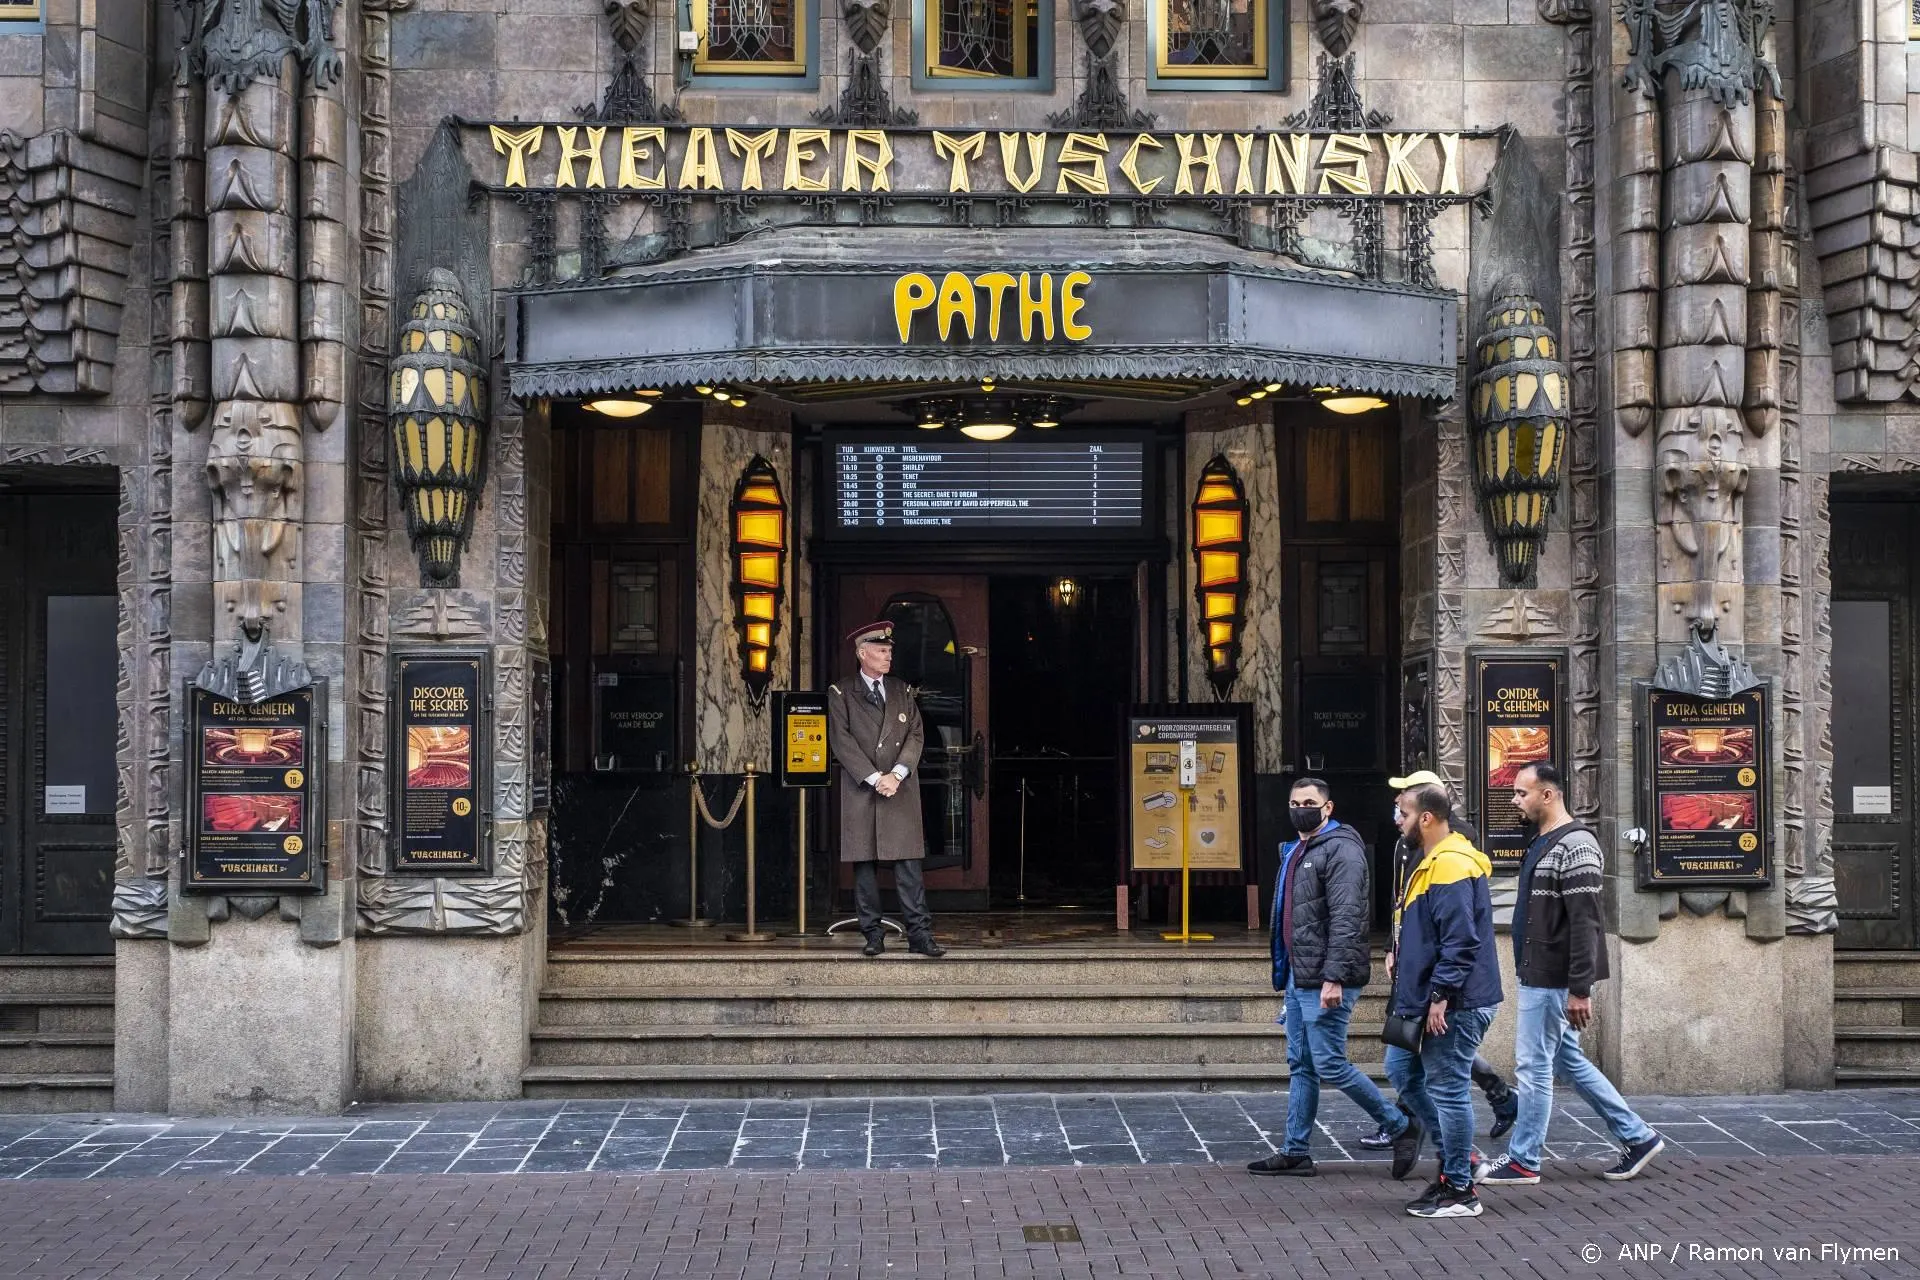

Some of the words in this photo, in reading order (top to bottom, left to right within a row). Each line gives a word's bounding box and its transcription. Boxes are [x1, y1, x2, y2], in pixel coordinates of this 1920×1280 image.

[489, 124, 894, 192] THEATER
[933, 131, 1462, 197] TUSCHINSKI
[893, 271, 1093, 344] PATHE
[1089, 445, 1104, 453] ZAAL
[1092, 481, 1098, 489] 4
[1092, 490, 1098, 498] 2
[979, 500, 1018, 508] COPPERFIELD,
[843, 518, 859, 526] 20:45
[902, 518, 941, 526] TOBACCONIST,
[413, 687, 465, 699] DISCOVER
[1497, 688, 1540, 700] ONTDEK
[213, 702, 245, 715] EXTRA
[249, 702, 295, 715] GENIETEN
[410, 699, 427, 711] THE
[430, 699, 469, 711] SECRETS
[1487, 701, 1501, 712] DE
[1503, 700, 1550, 712] GEHEIMEN
[1666, 703, 1698, 716] EXTRA
[1700, 703, 1746, 715] GENIETEN
[610, 712, 629, 720] TICKET
[631, 712, 664, 720] VERKOOP
[633, 721, 641, 729] DE
[410, 850, 461, 859] TUSCHINSKI
[1492, 849, 1525, 857] TUSCHI
[220, 864, 278, 873] TUSCHINSKI
[1680, 861, 1734, 870] TUSCHINSKI
